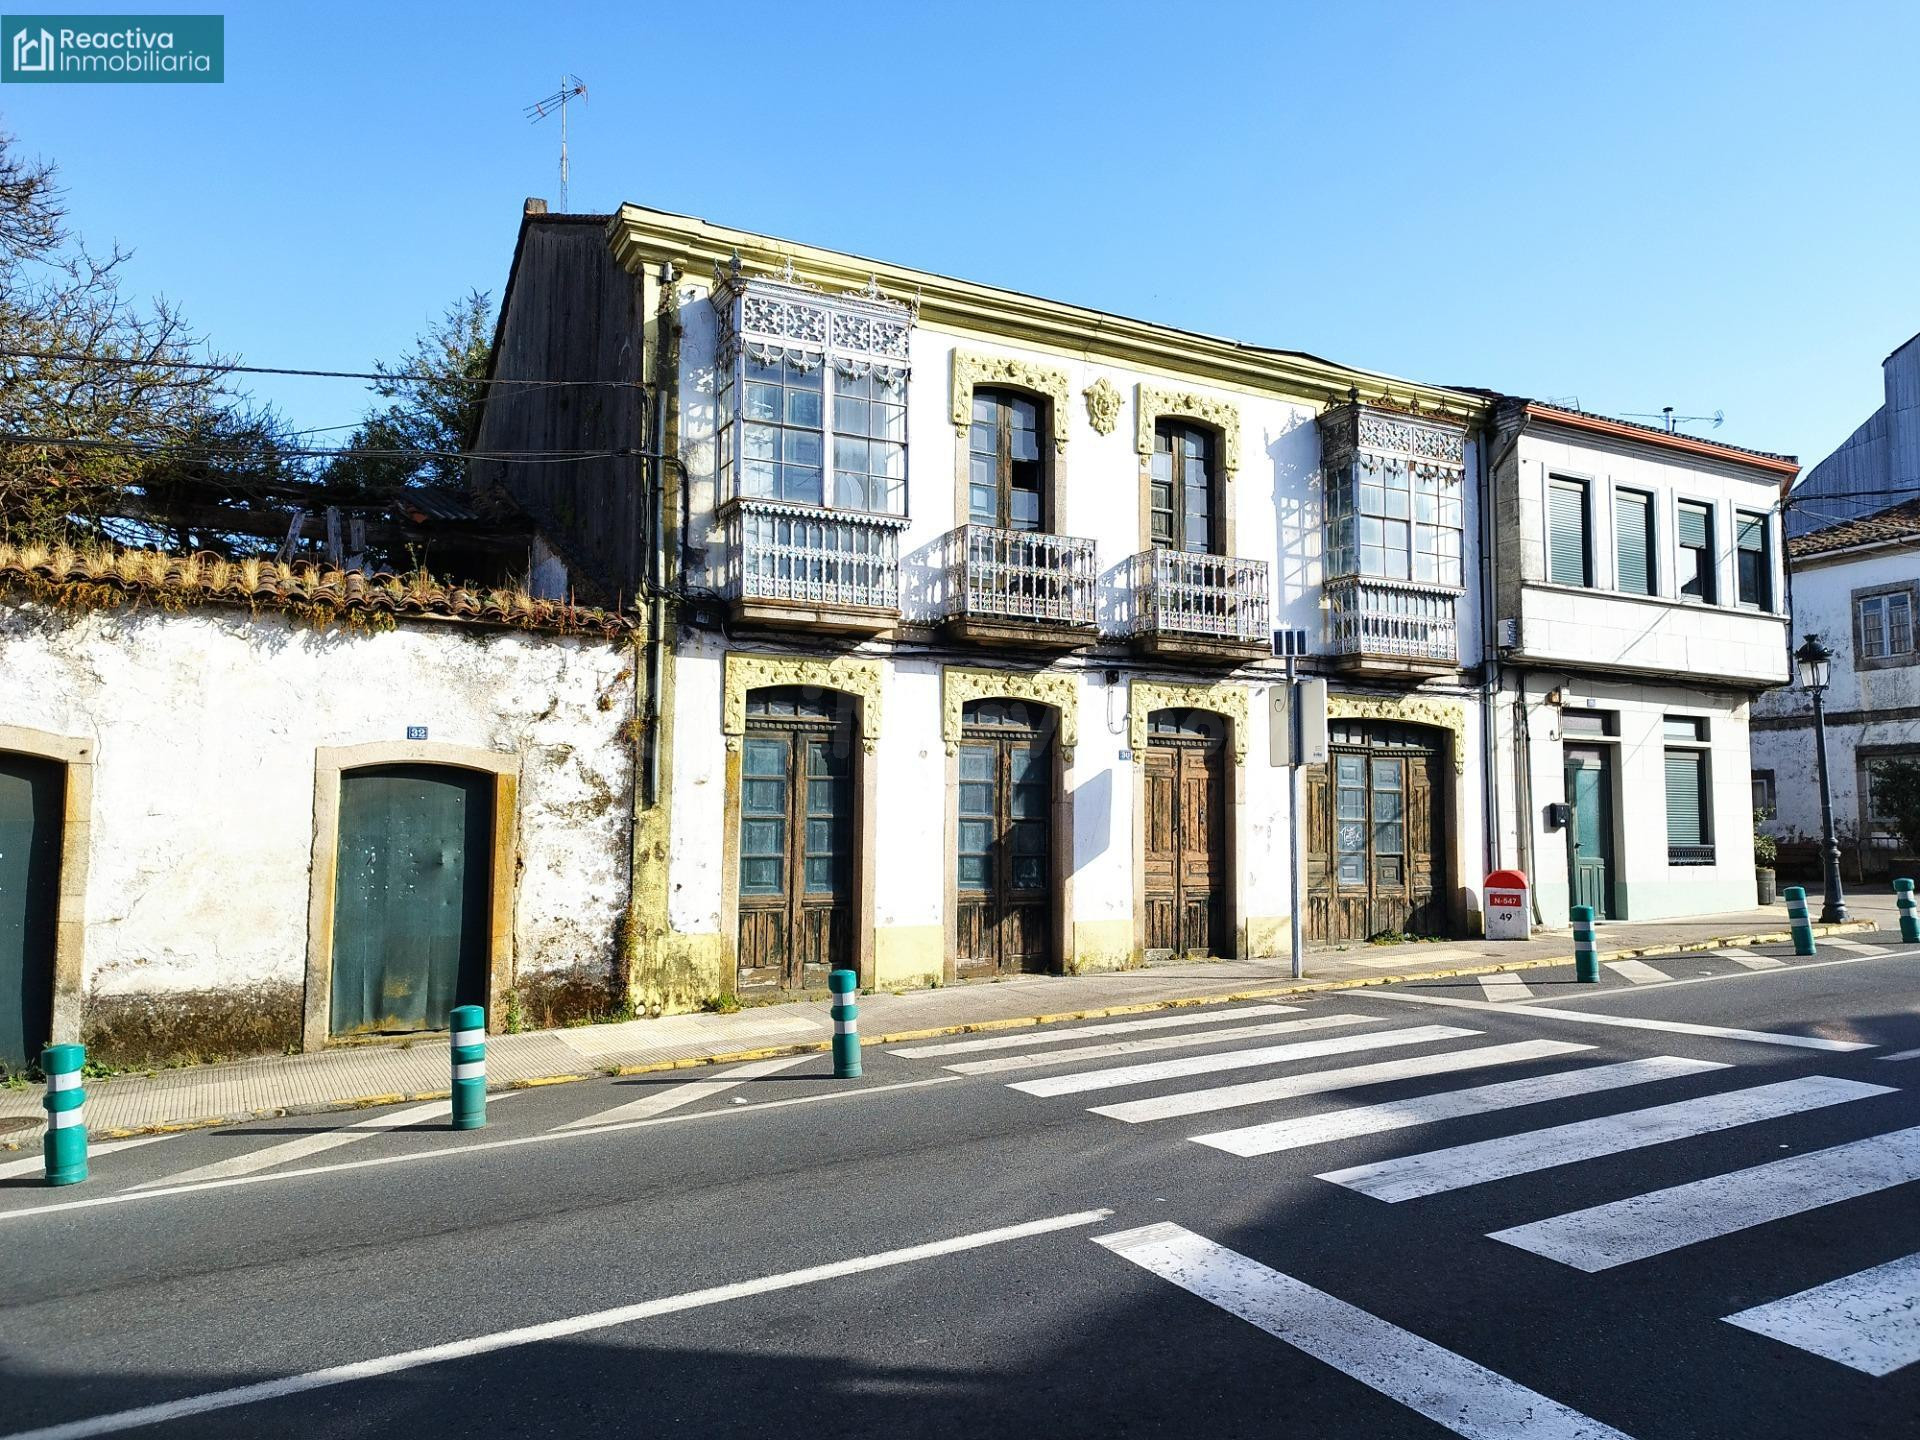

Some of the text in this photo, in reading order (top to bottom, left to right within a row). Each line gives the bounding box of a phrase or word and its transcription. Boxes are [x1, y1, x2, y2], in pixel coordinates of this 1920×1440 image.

[411, 728, 426, 737] 32
[1494, 897, 1517, 905] N-547
[1499, 913, 1513, 922] 49
